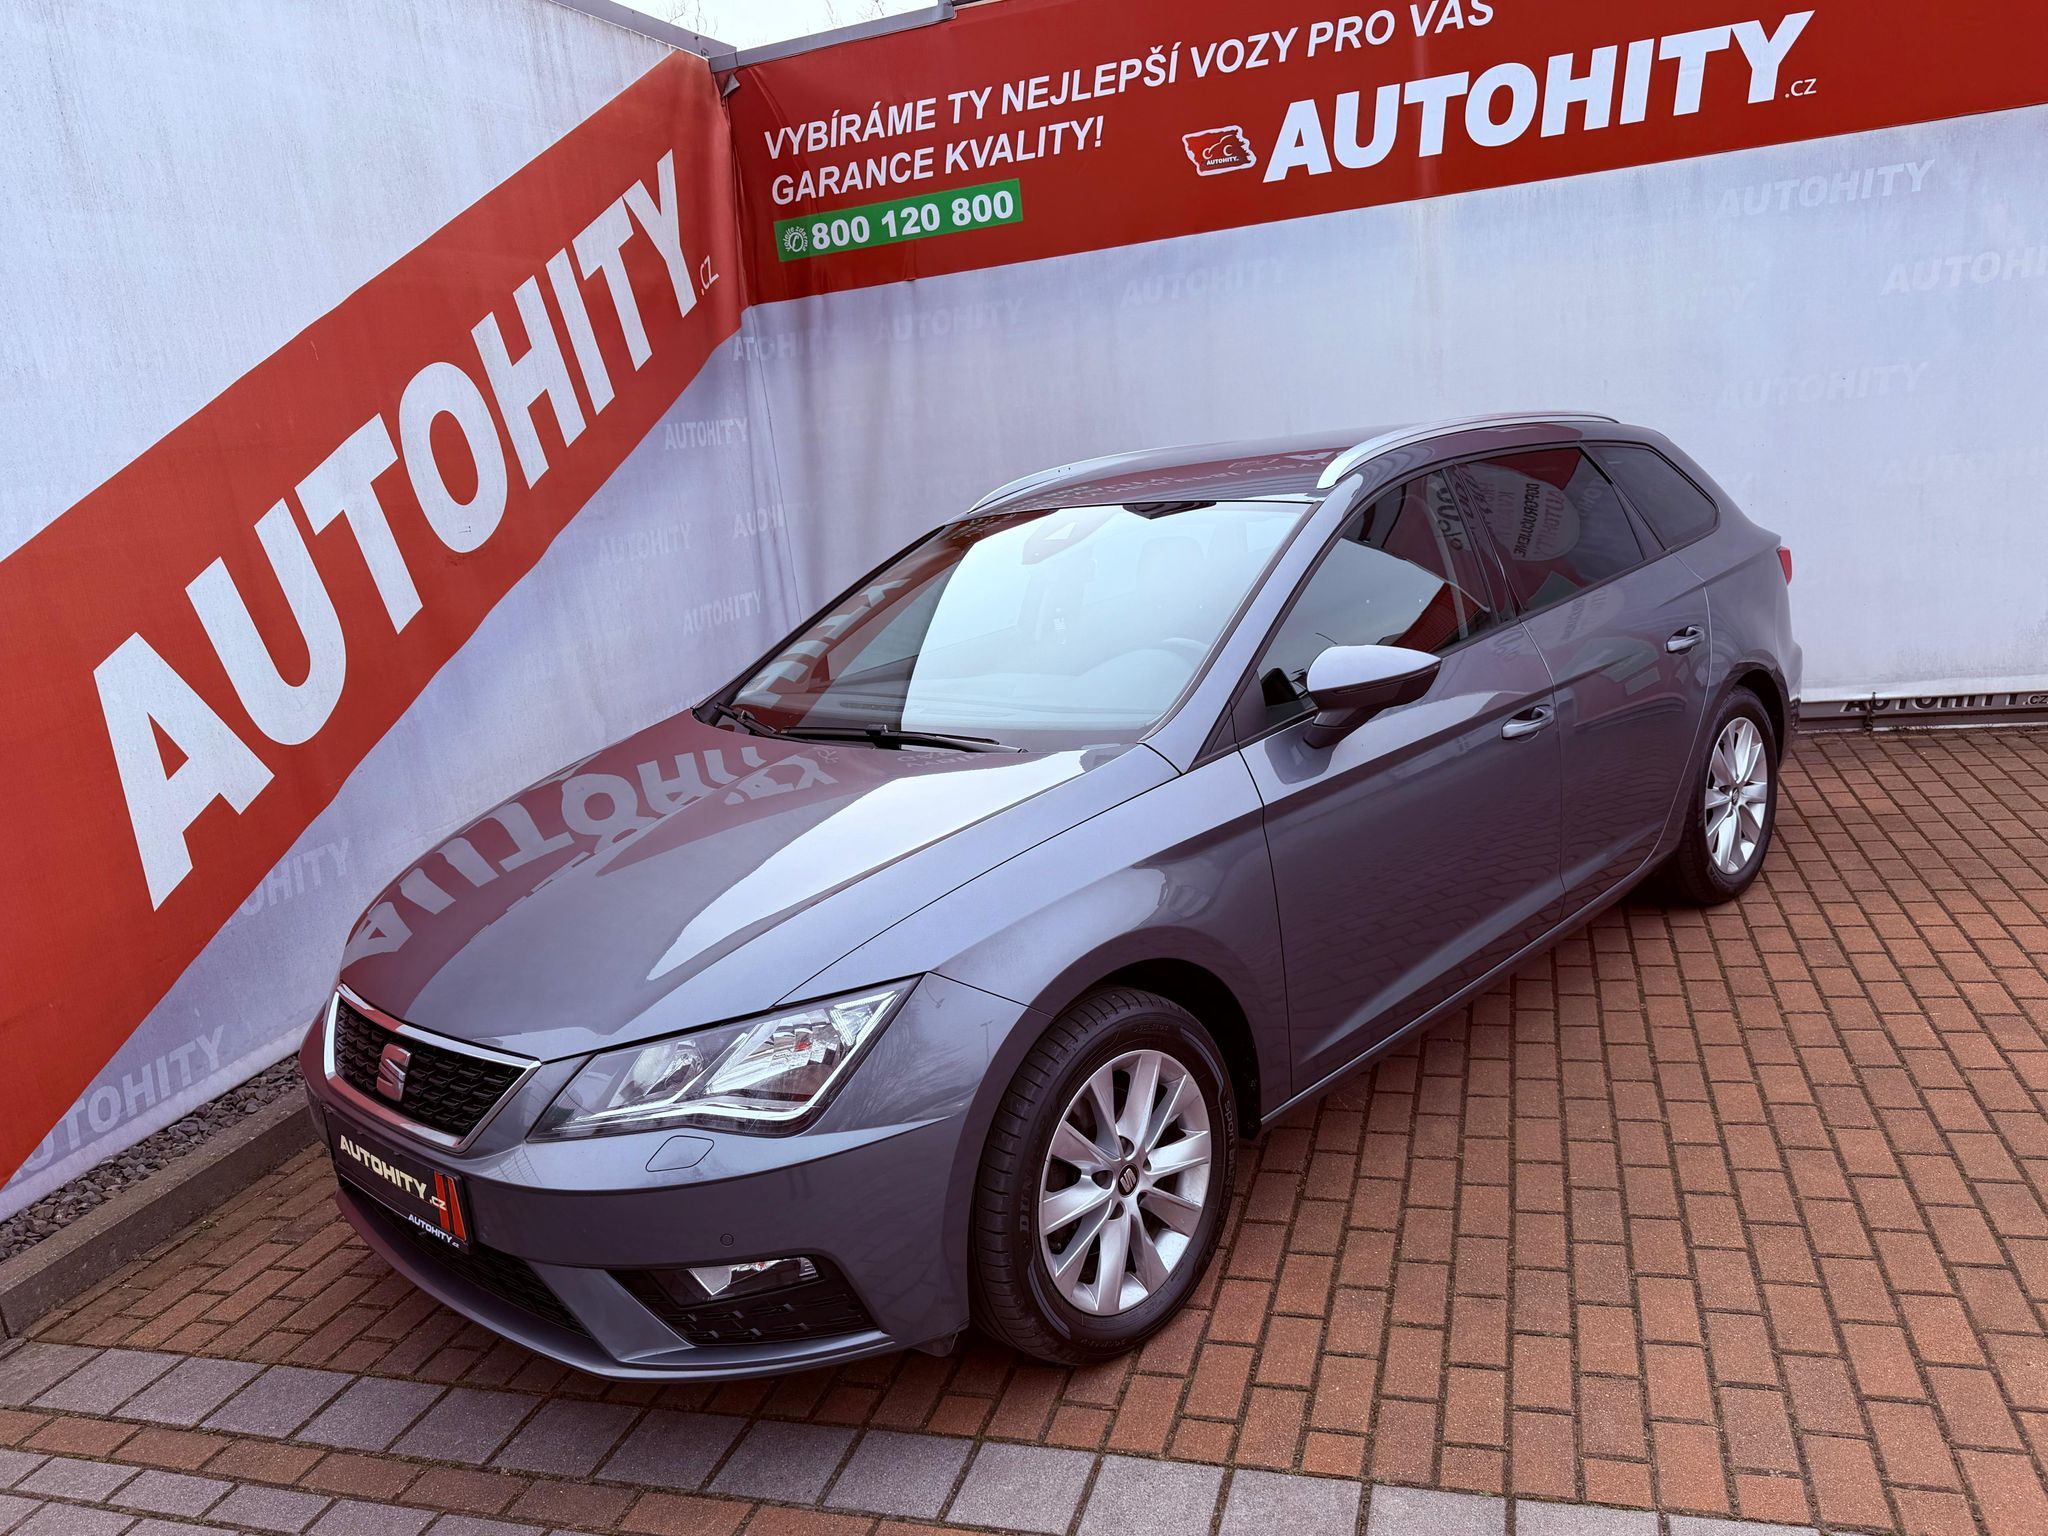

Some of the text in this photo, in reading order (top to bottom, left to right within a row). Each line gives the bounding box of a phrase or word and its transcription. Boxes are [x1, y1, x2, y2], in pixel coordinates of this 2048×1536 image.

[763, 97, 937, 160] VYBÍRÁME
[947, 86, 993, 124] TY
[1001, 42, 1182, 114] NEJLEPŠÍ
[1190, 27, 1298, 78] VOZY
[1306, 9, 1396, 58] PRO
[771, 115, 1105, 206] GARANCE KVALITY!
[811, 190, 1014, 250] 800 120 800
[665, 417, 749, 450] AUTOHITY
